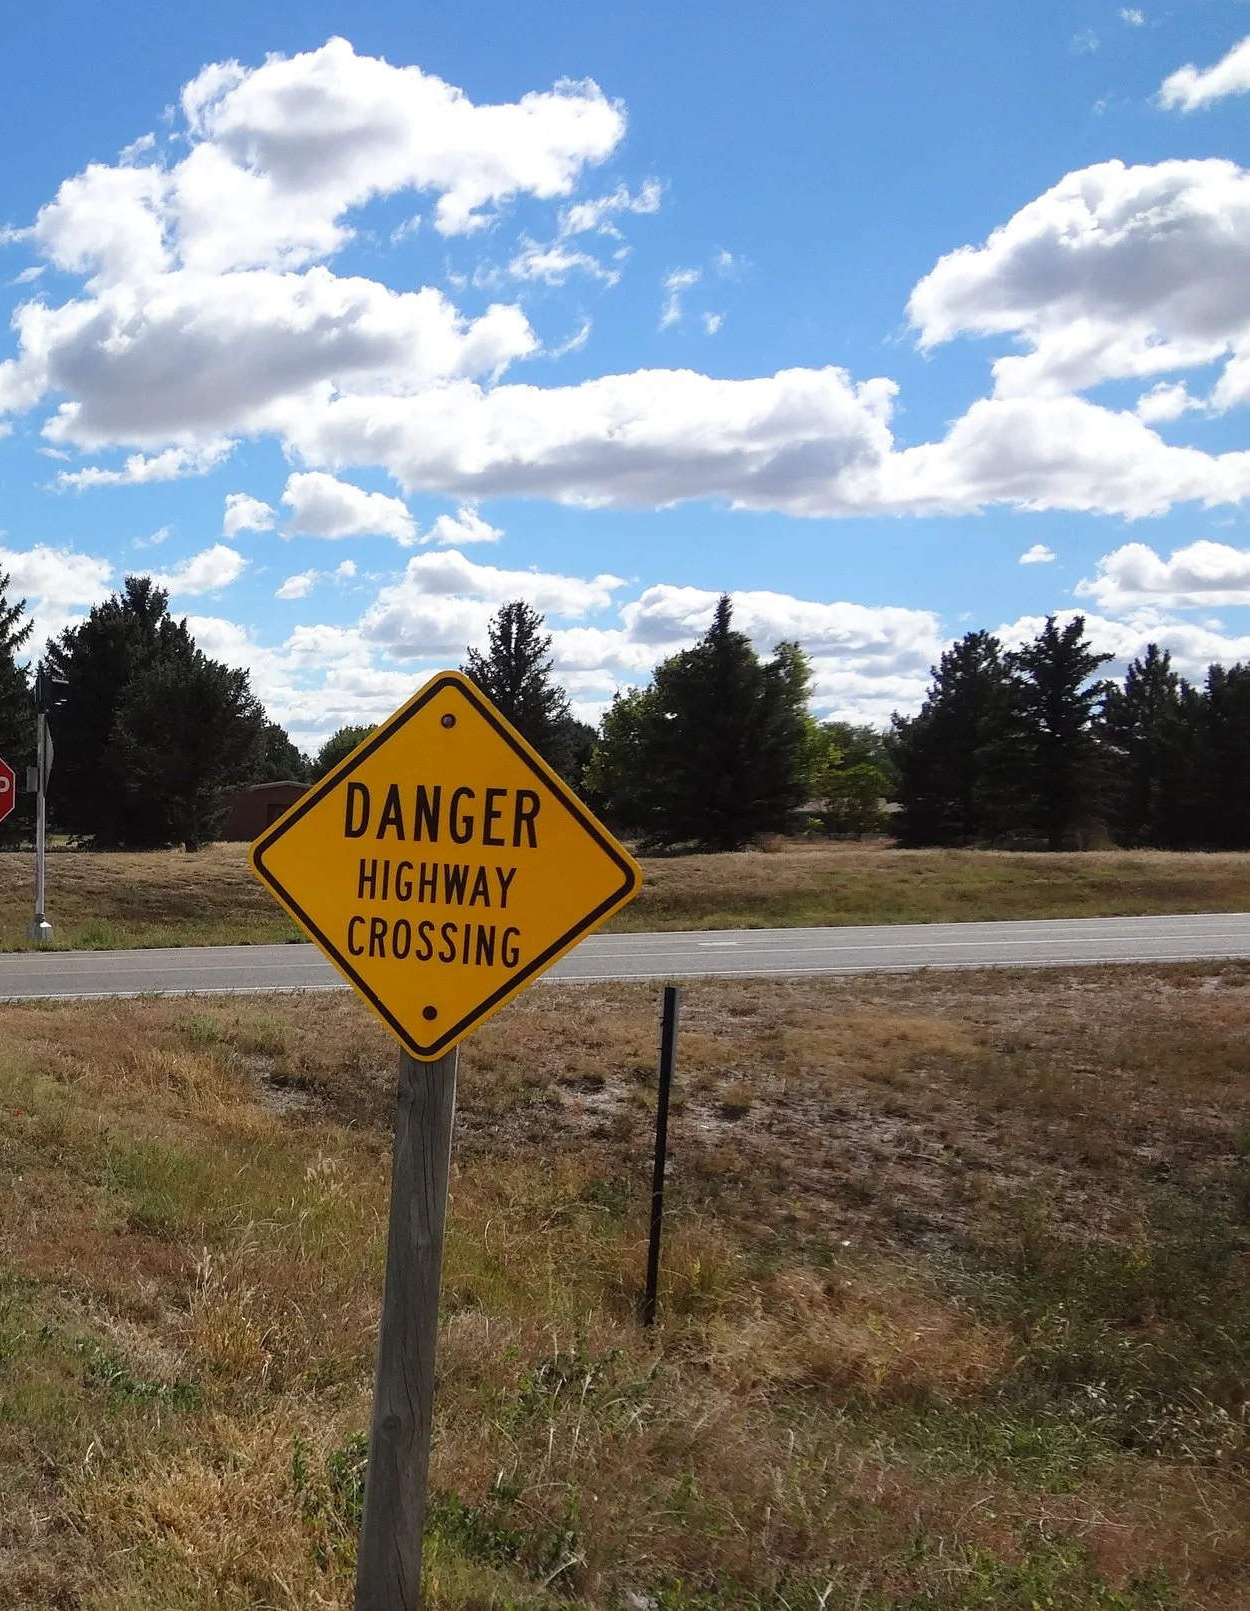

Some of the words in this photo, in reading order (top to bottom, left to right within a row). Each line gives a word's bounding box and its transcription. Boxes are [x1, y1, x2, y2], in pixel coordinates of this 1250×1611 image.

[344, 782, 541, 848] DANGER
[358, 858, 517, 908] HIGHWAY
[348, 915, 521, 968] CROSSING
